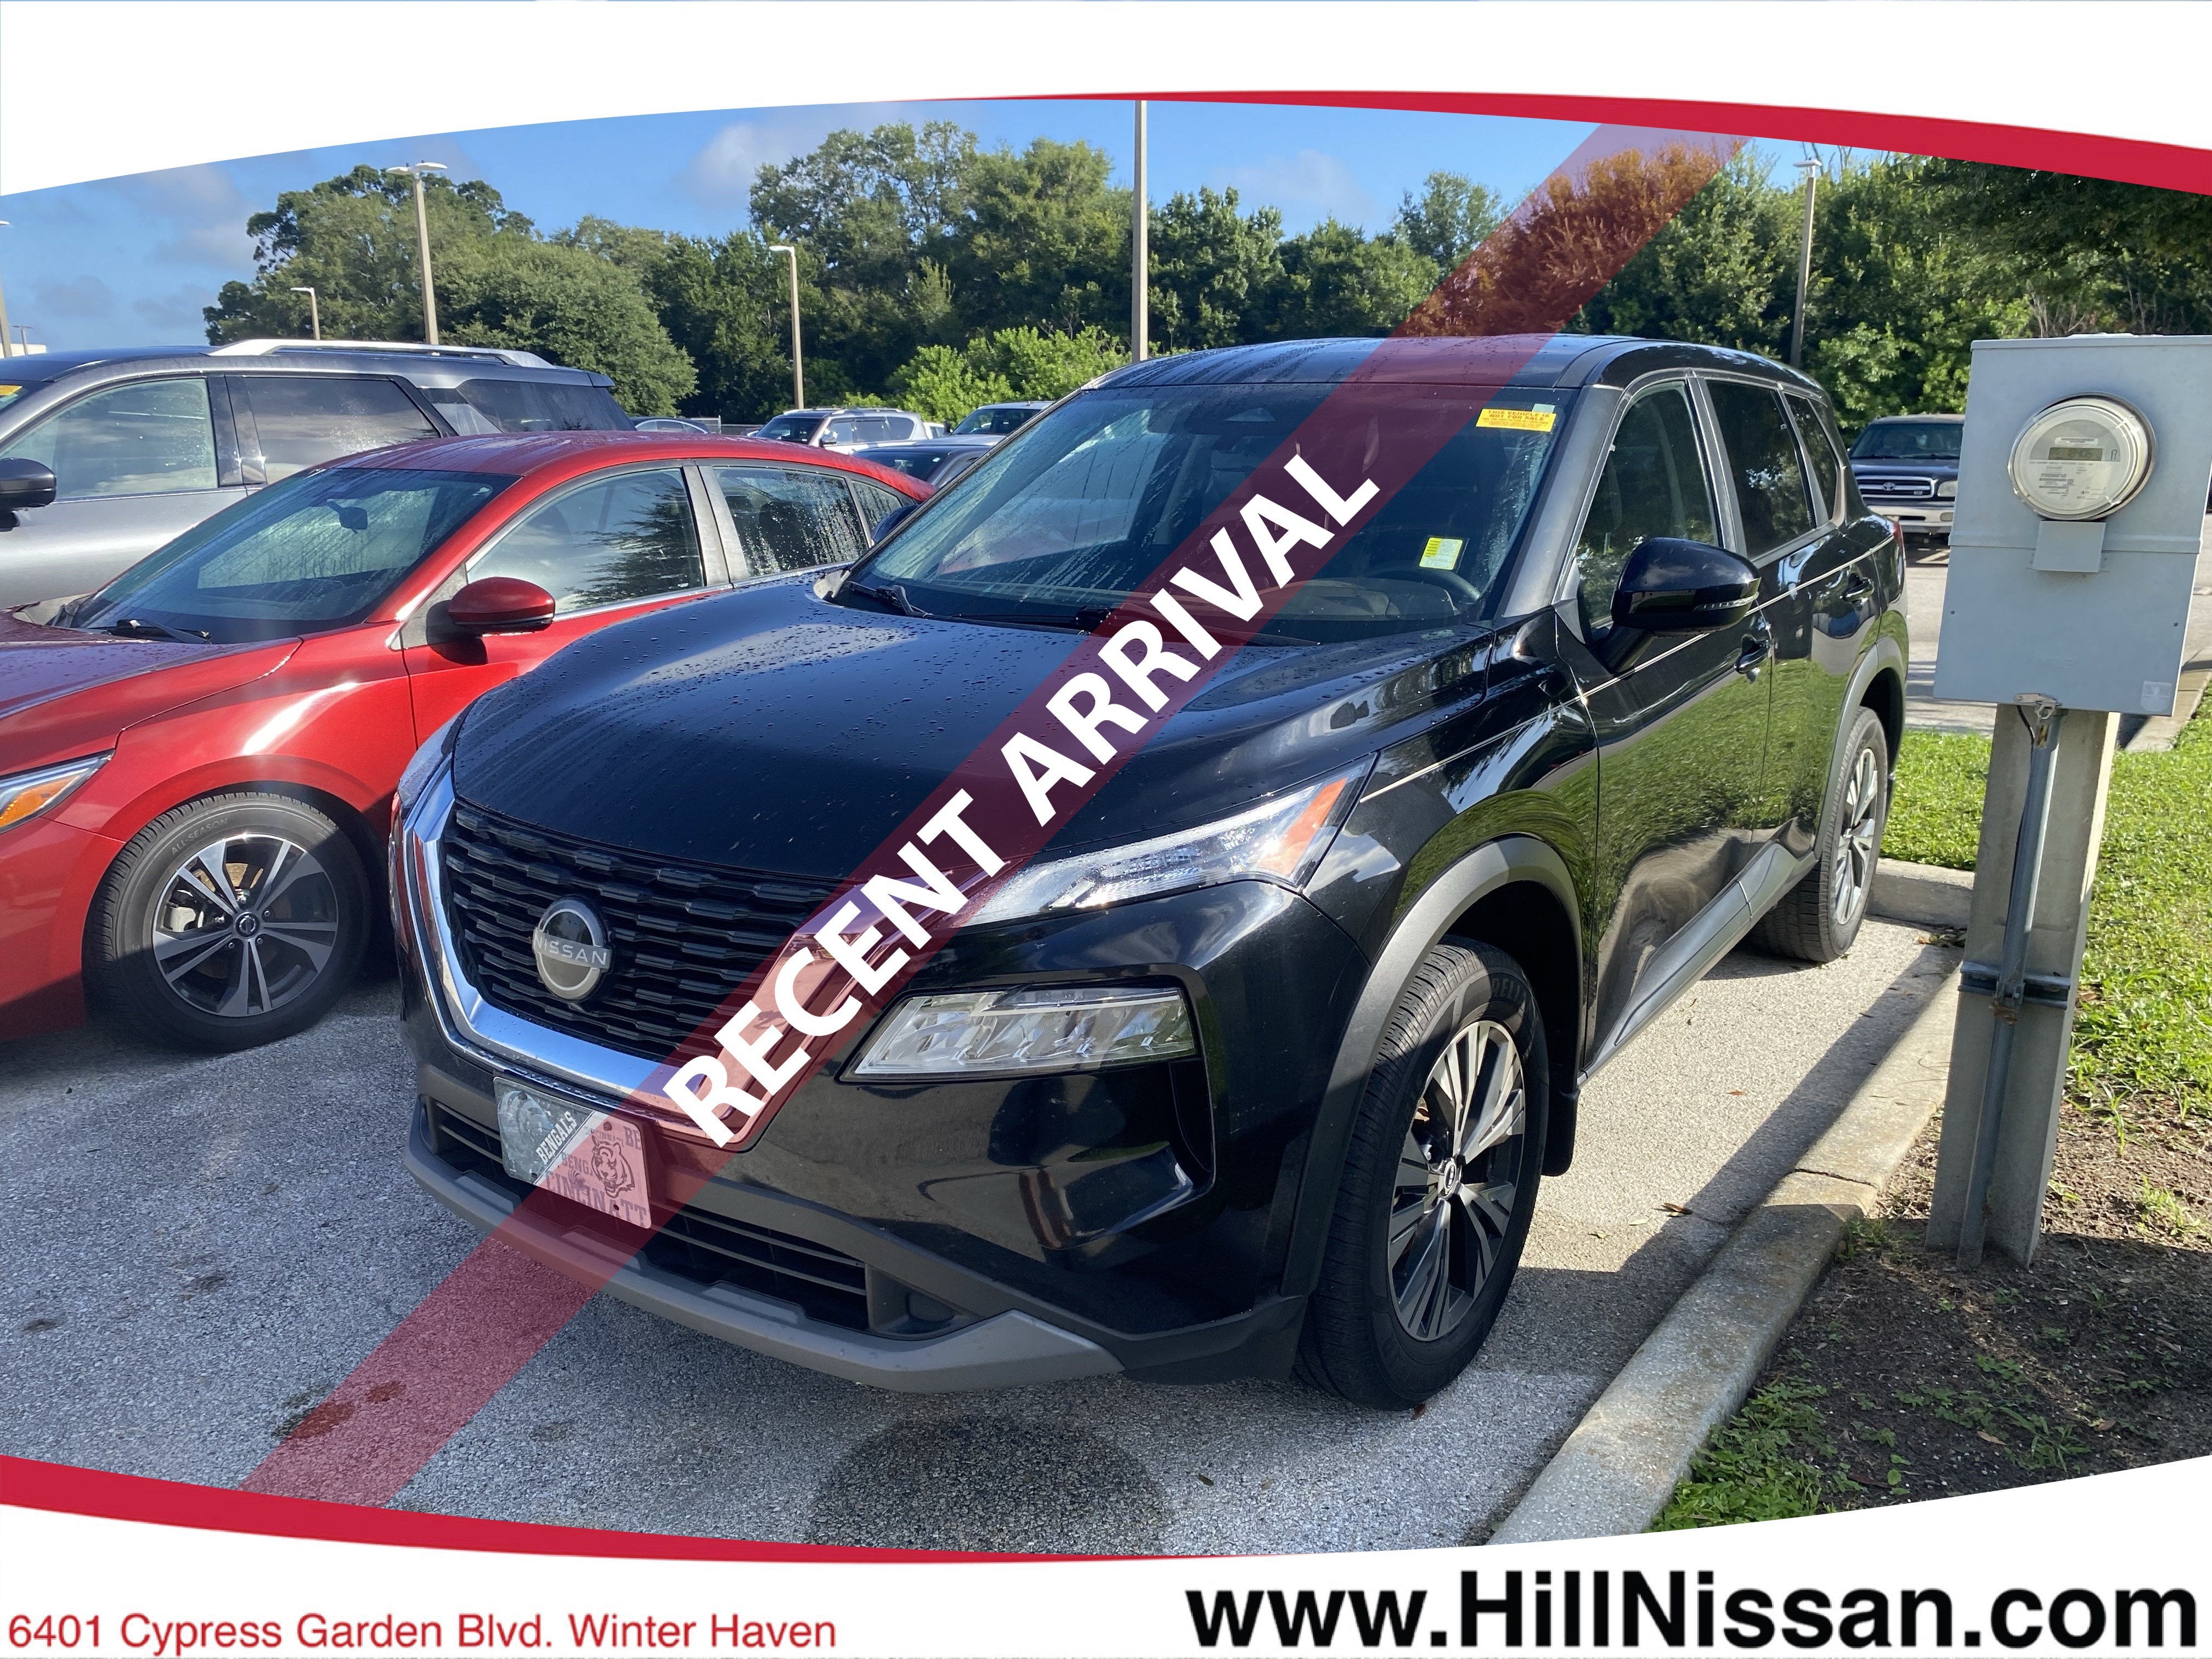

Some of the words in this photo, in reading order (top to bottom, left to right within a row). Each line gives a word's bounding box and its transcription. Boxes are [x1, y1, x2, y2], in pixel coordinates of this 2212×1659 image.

[171, 817, 229, 856] ALL-SEASON
[533, 932, 607, 966] NISSAN
[535, 1110, 577, 1165] BENGALS
